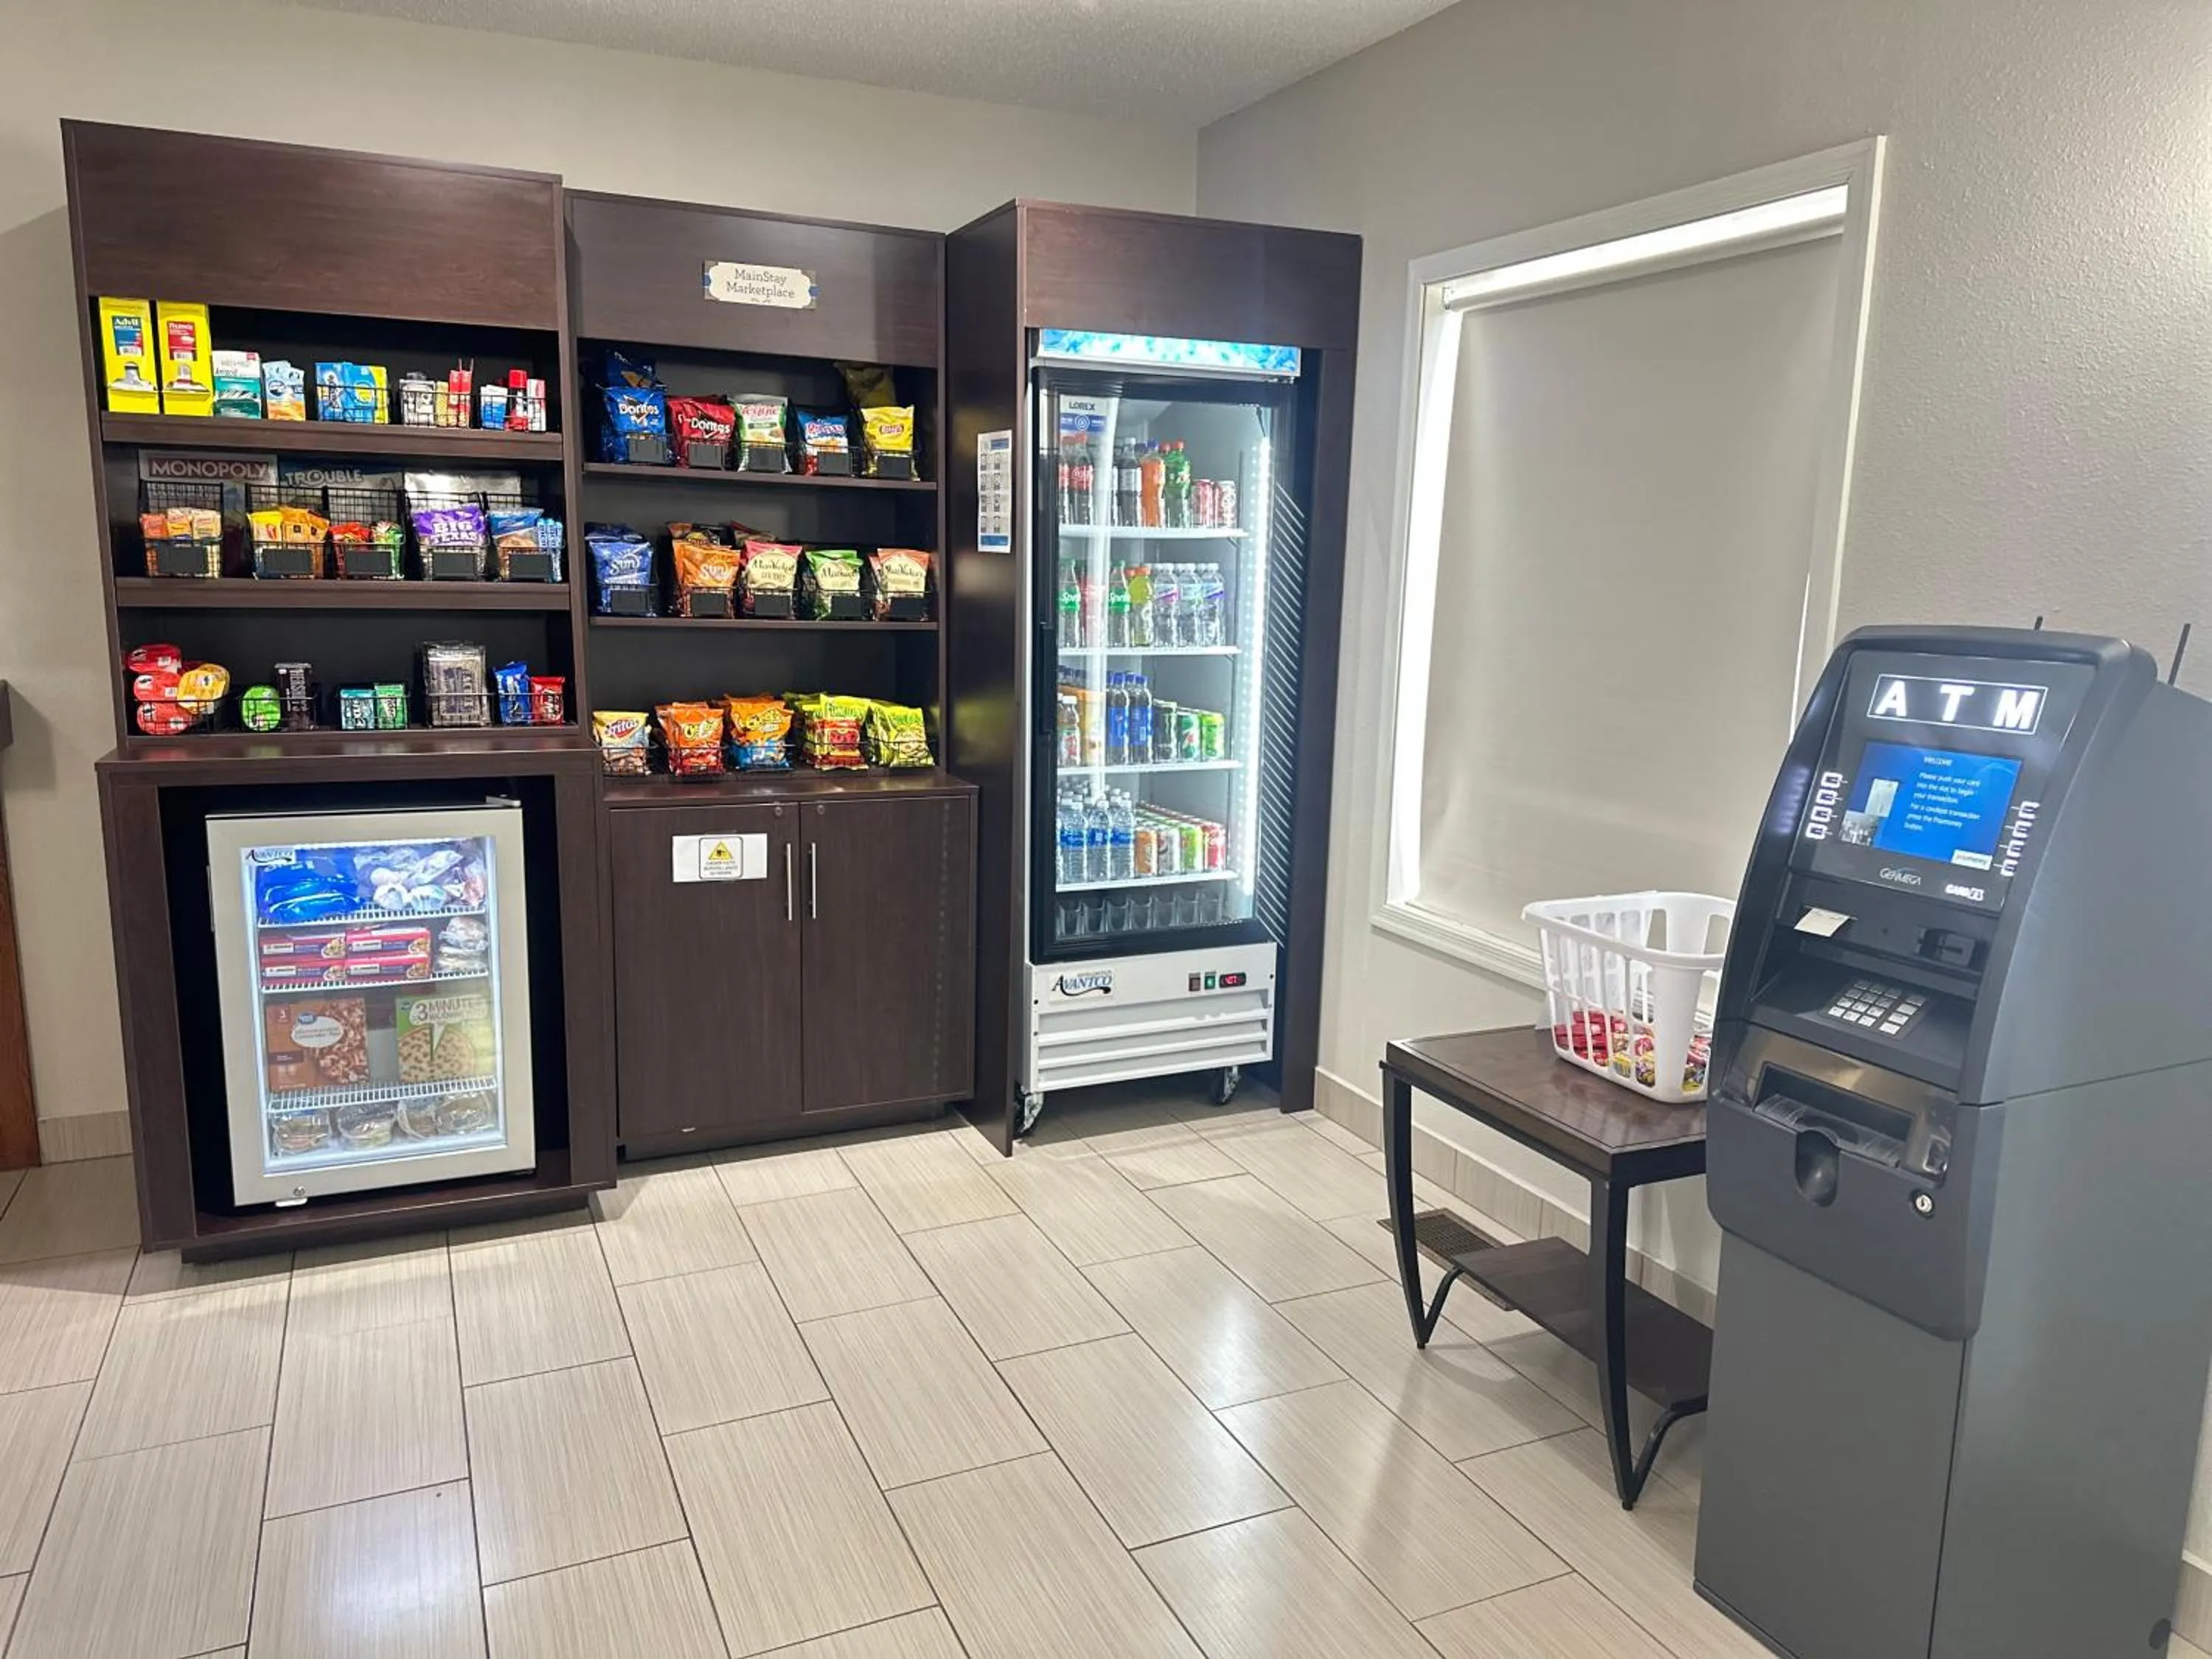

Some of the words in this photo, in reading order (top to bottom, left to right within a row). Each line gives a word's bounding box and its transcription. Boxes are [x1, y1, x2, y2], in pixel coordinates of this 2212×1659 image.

[734, 268, 787, 286] MainStay
[726, 281, 795, 299] Marketplace
[619, 402, 659, 415] Doritos
[1069, 400, 1096, 411] LOREX
[690, 418, 731, 434] Doritos
[151, 459, 268, 479] MONOPOLY
[285, 468, 366, 487] TROUBLE
[432, 521, 472, 532] BIG
[430, 532, 478, 544] TEXAS
[289, 669, 307, 712] HERSHY'S
[1875, 679, 2041, 731] ATM
[1051, 973, 1113, 997] AVANTCO
[415, 1002, 428, 1021] 3
